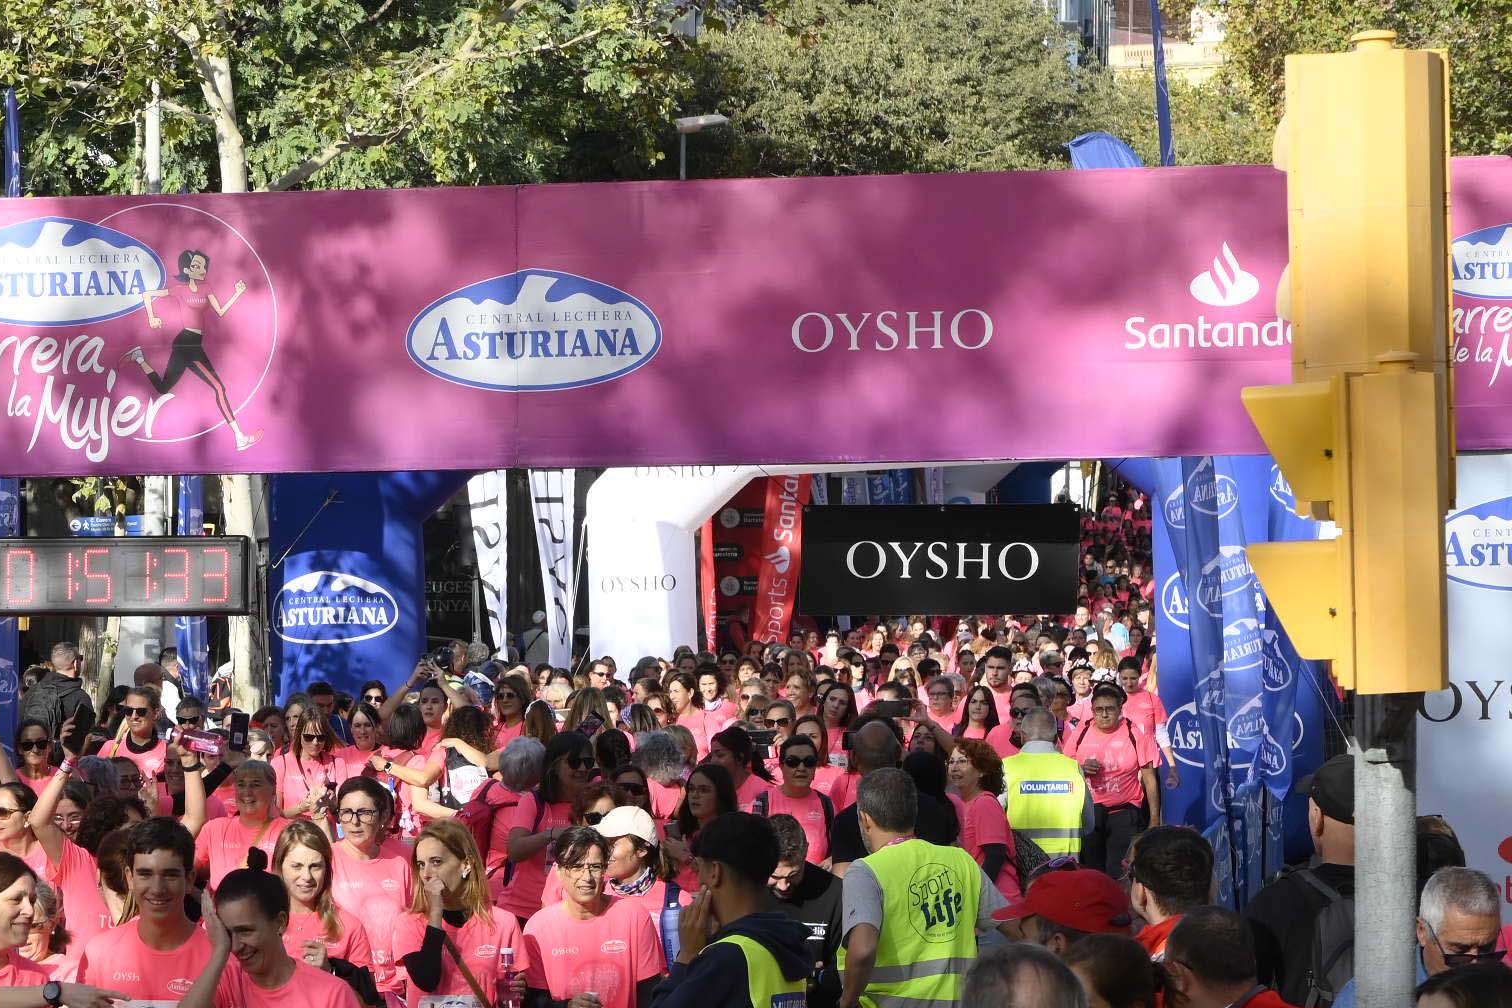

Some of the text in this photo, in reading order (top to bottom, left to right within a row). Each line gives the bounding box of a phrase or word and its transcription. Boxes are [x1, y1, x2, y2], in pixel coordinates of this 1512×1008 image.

[68, 253, 141, 265] LECHERA
[1465, 249, 1512, 259] CENTRA
[465, 310, 633, 325] CENTRAL LECHERA
[791, 308, 994, 353] OYSHO
[1452, 304, 1512, 335] arre
[425, 317, 642, 361] ASTURIANA
[1474, 335, 1493, 363] la
[7, 375, 32, 418] la
[26, 369, 176, 463] Mujer
[773, 473, 799, 543] Santa
[845, 540, 1040, 581] OYSHO
[288, 595, 331, 605] CENTRAL
[600, 574, 677, 593] OYSHO
[276, 602, 389, 628] ASTURIANA
[1417, 680, 1512, 723] OY
[1021, 782, 1069, 792] VOLUNTARIS
[909, 869, 954, 907] Sport
[920, 888, 963, 931] Life
